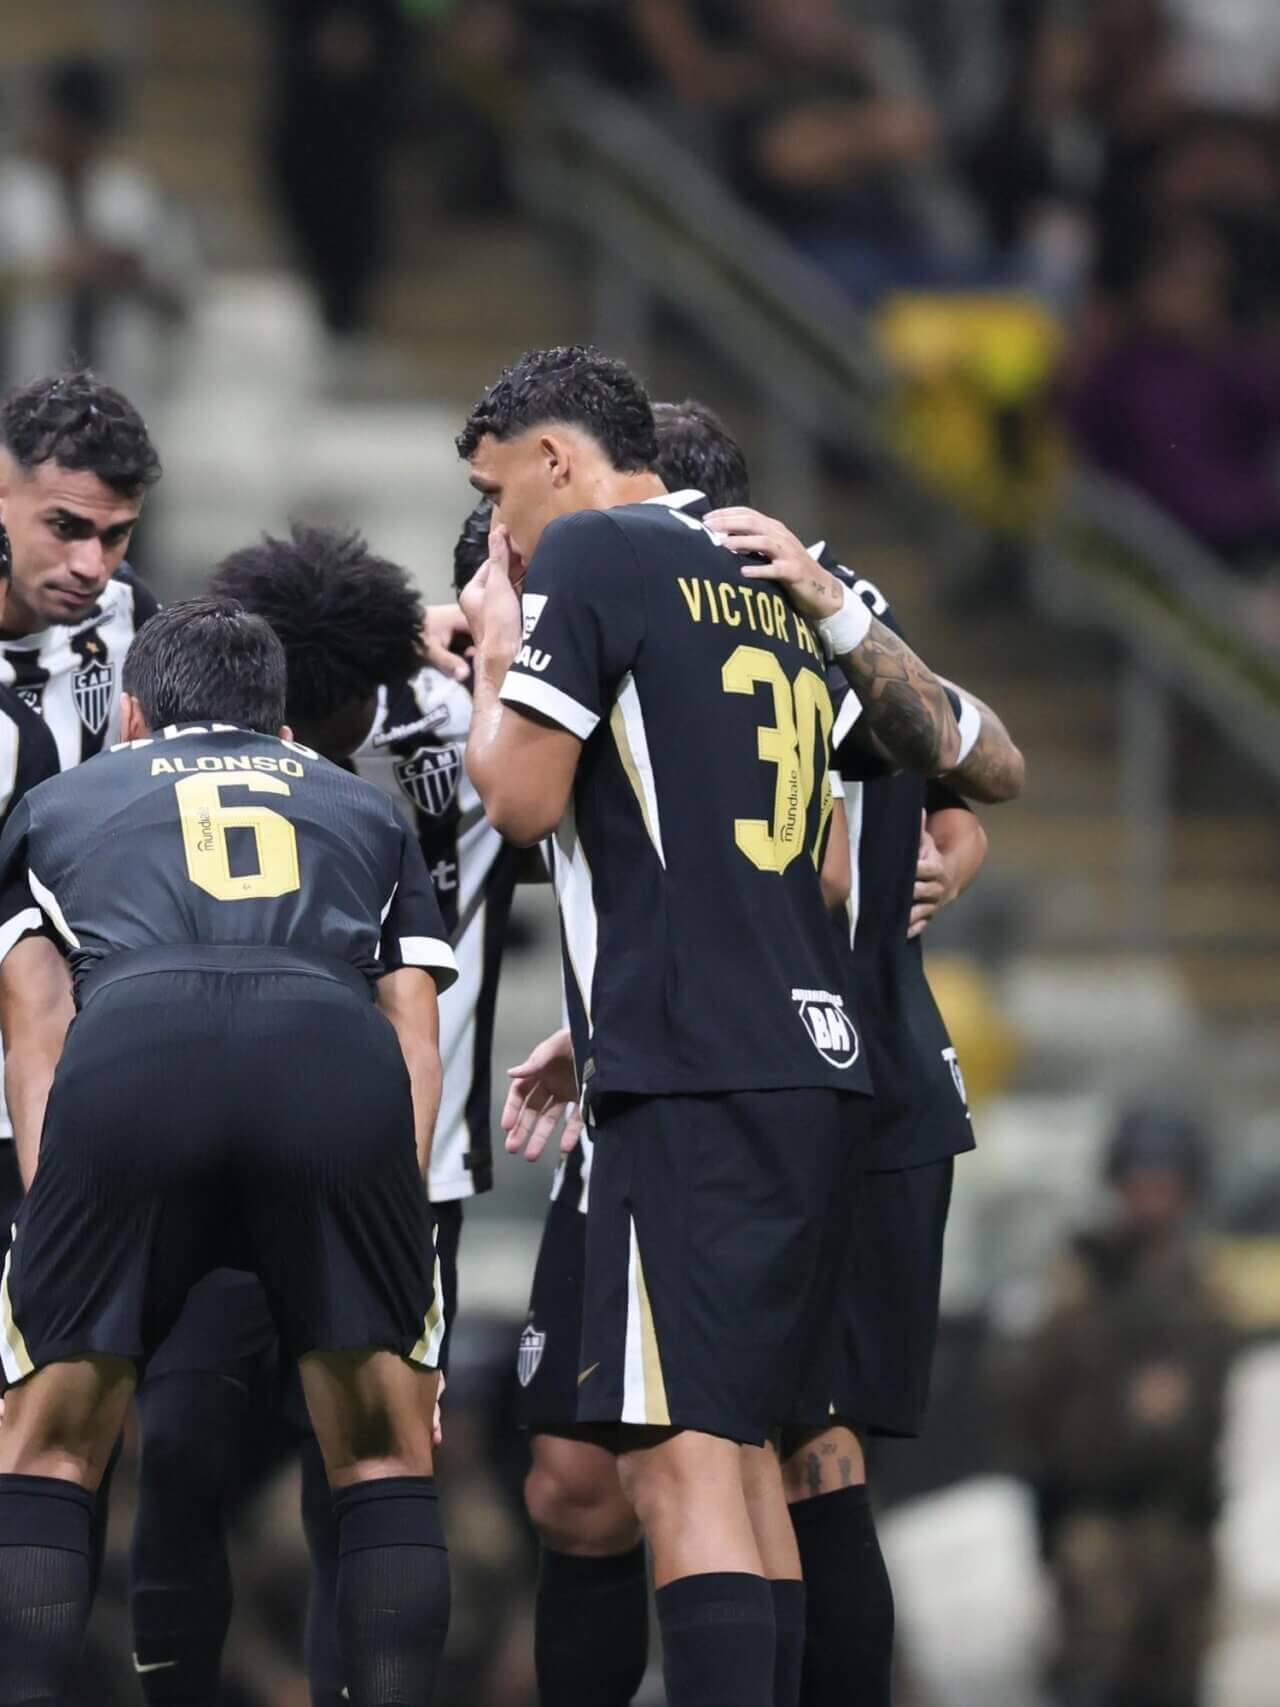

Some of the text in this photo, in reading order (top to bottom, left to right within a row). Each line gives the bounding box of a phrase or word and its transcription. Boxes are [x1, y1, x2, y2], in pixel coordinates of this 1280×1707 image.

[677, 577, 790, 642] VICTOR
[151, 755, 305, 777] ALONSO
[721, 644, 834, 876] 30
[174, 770, 301, 901] 6
[780, 769, 799, 843] mundiale
[807, 1006, 851, 1051] BH
